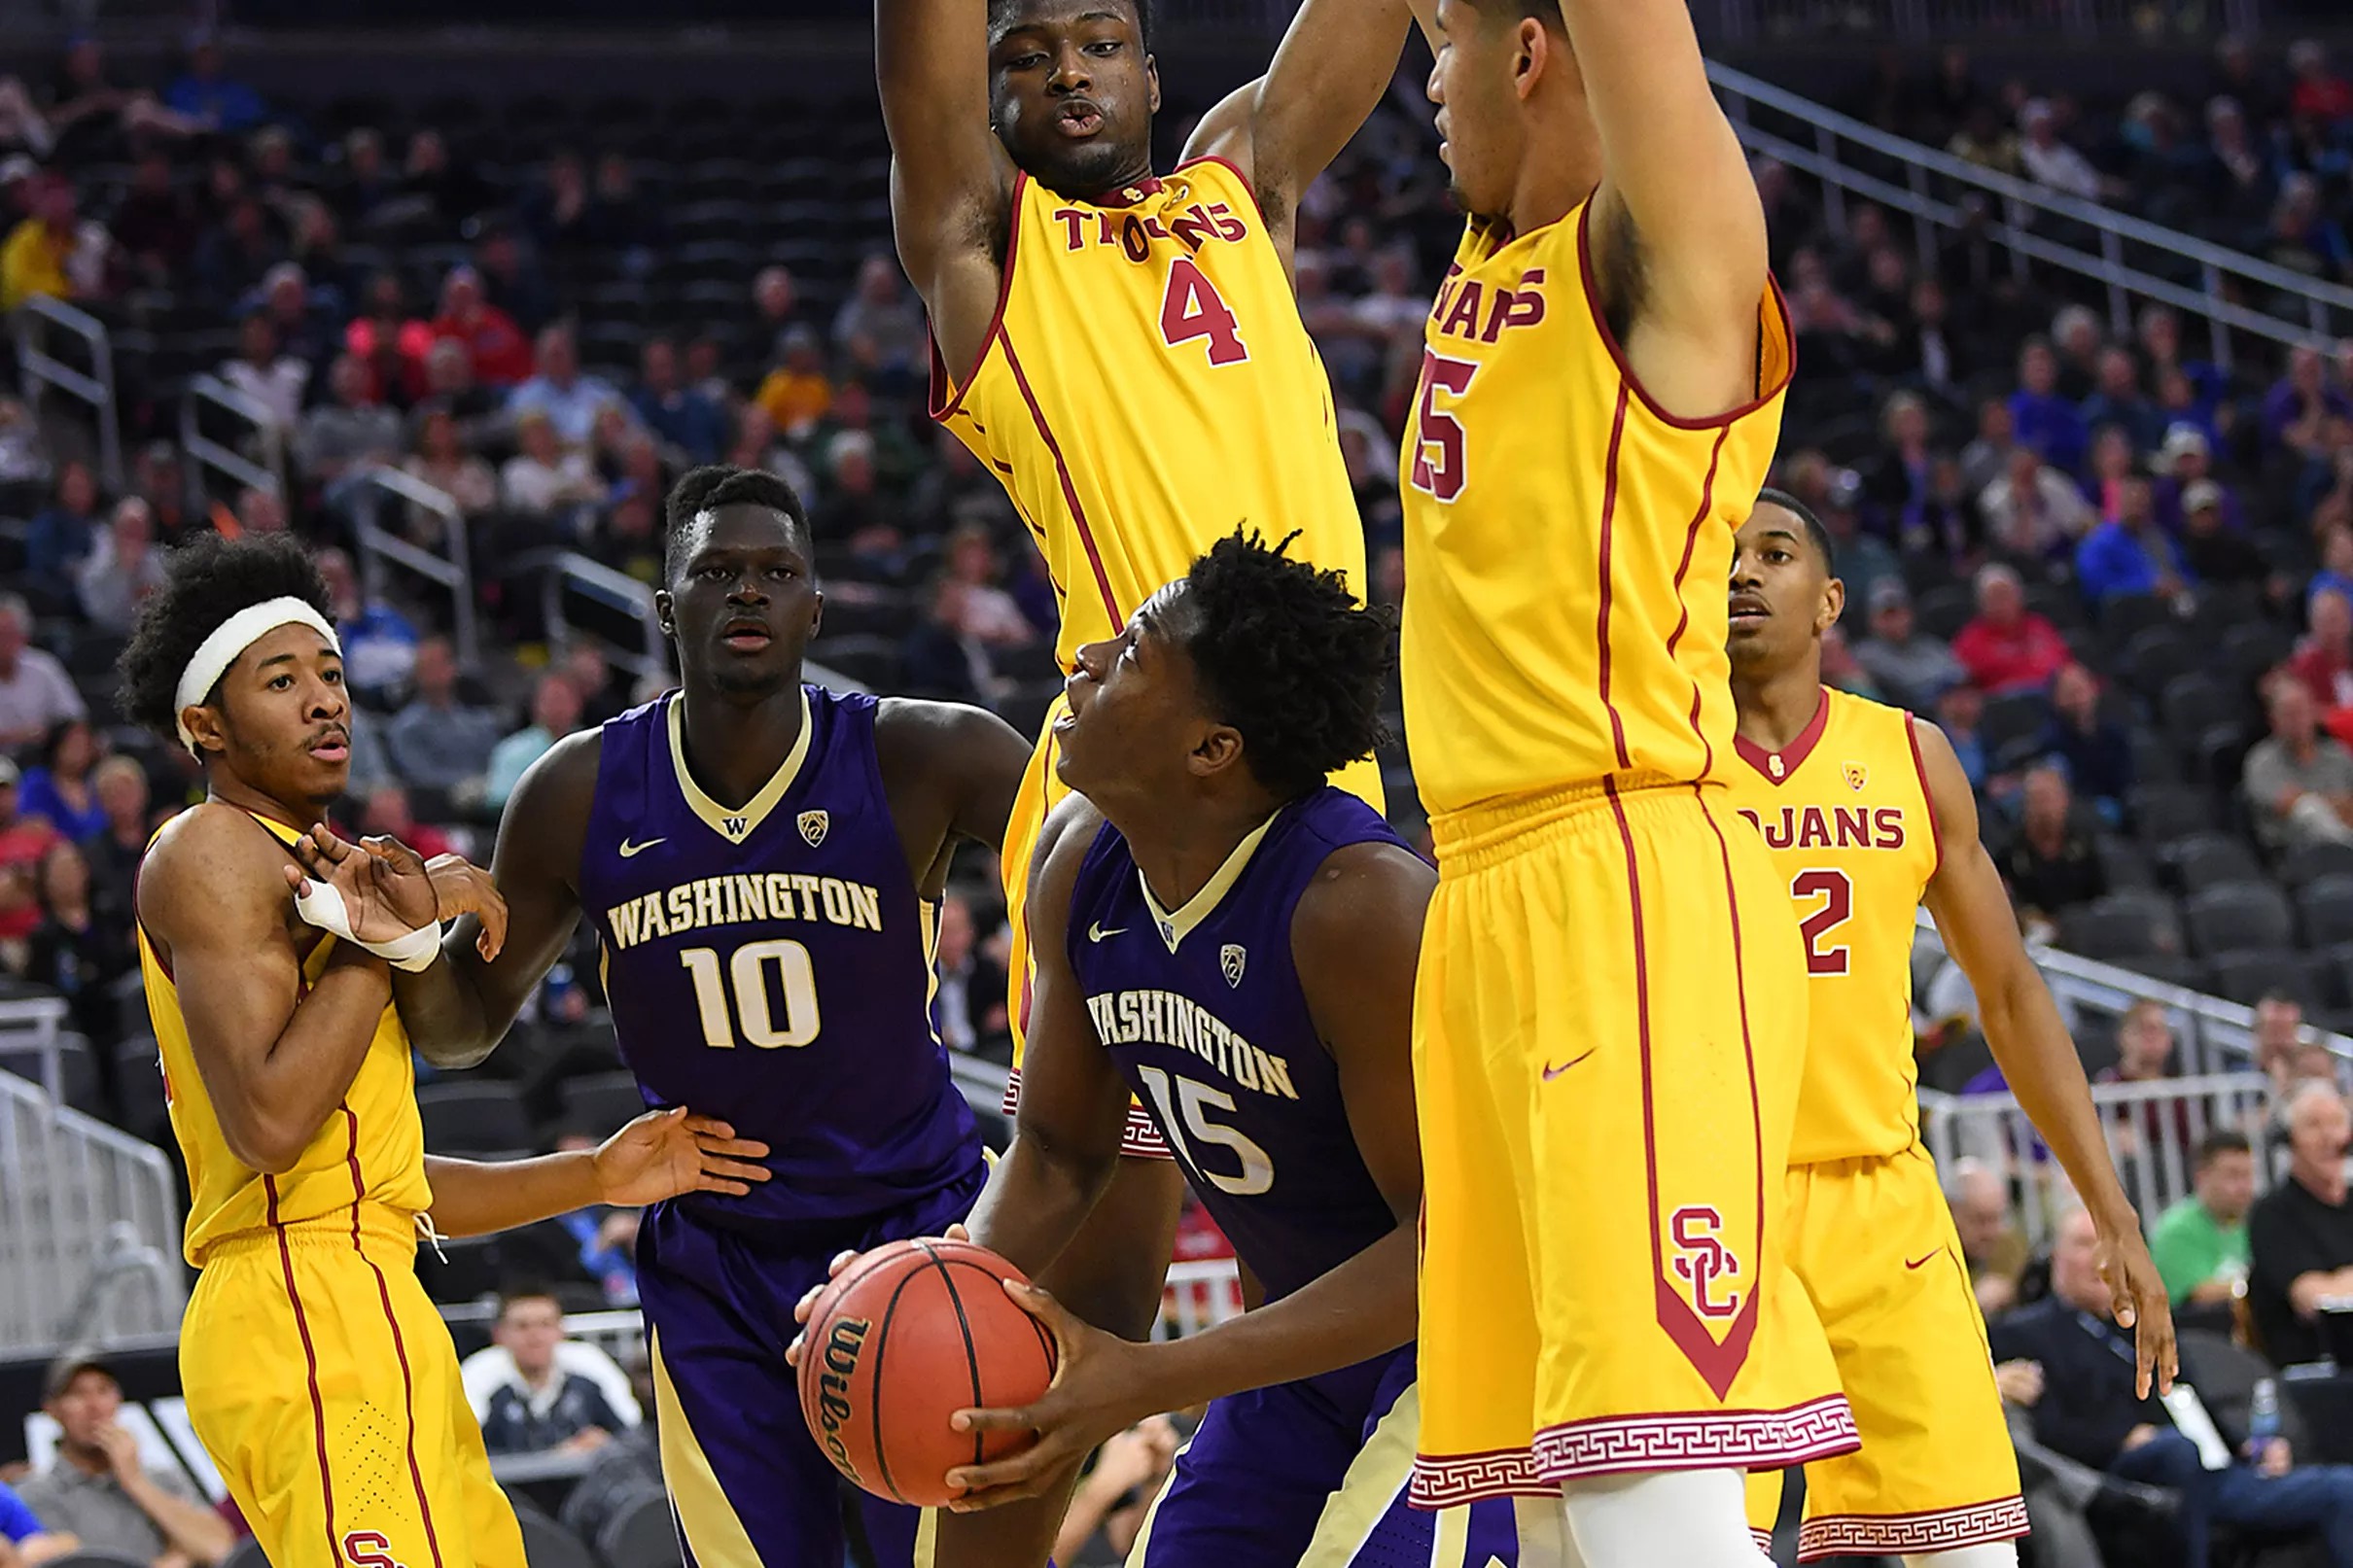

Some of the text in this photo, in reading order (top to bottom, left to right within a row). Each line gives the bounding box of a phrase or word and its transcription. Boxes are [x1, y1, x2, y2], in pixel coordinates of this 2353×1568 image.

[1159, 258, 1250, 368] 4
[720, 817, 748, 836] W
[607, 873, 883, 950] WASHINGTON
[1790, 867, 1852, 977] 2
[680, 939, 822, 1049] 10
[1136, 1063, 1276, 1196] 15
